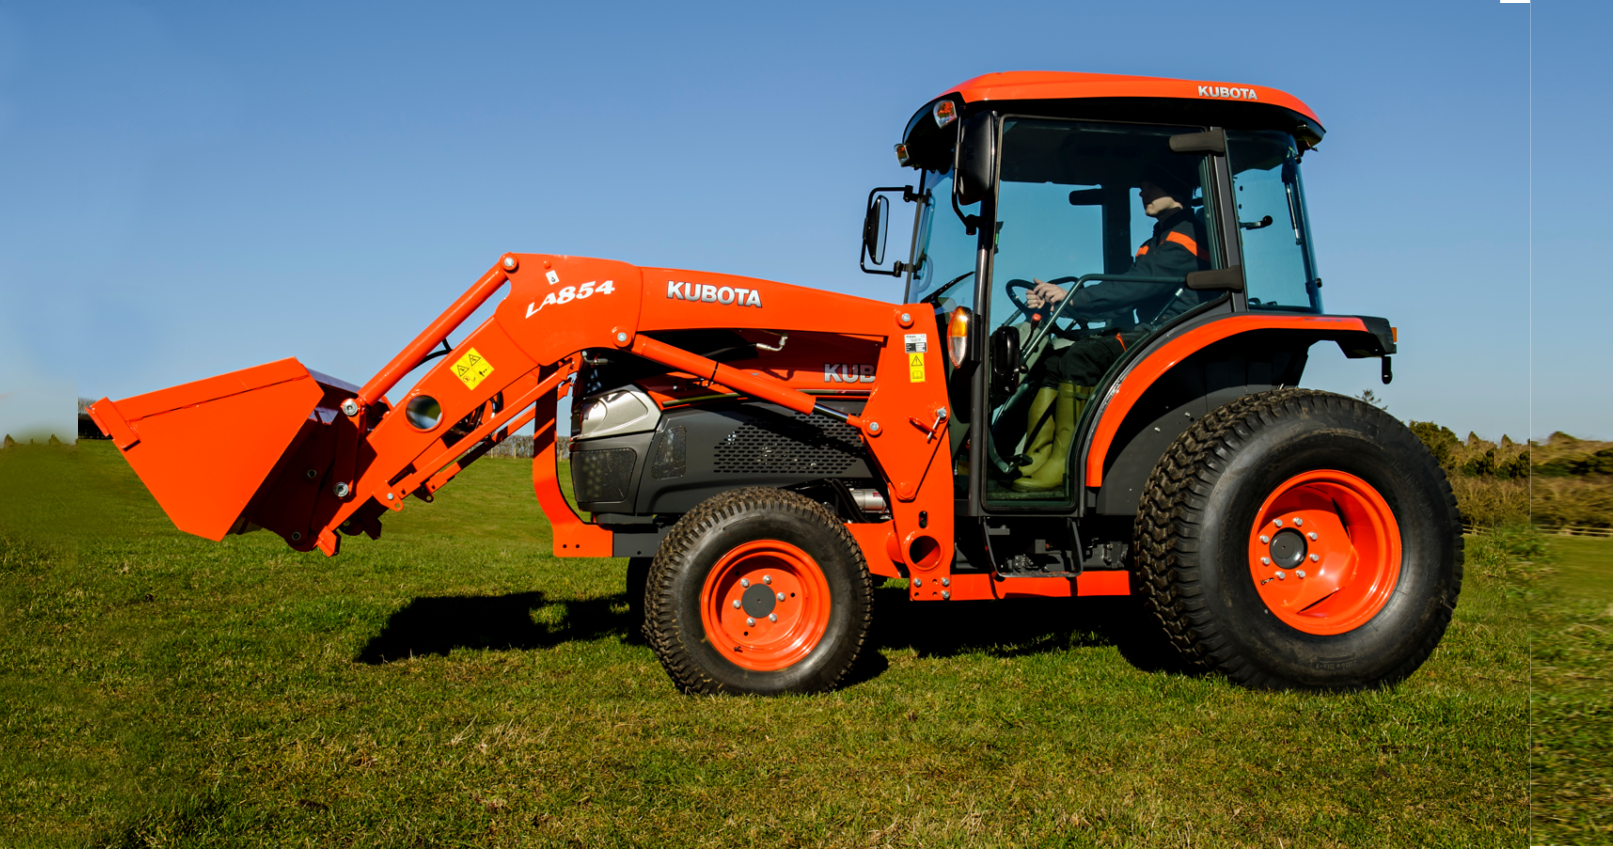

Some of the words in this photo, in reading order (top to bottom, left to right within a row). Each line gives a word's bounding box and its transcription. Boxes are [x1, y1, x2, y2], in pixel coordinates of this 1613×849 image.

[1197, 85, 1259, 101] KUBOTA
[525, 279, 616, 319] LA854
[666, 280, 763, 308] KUBOTA
